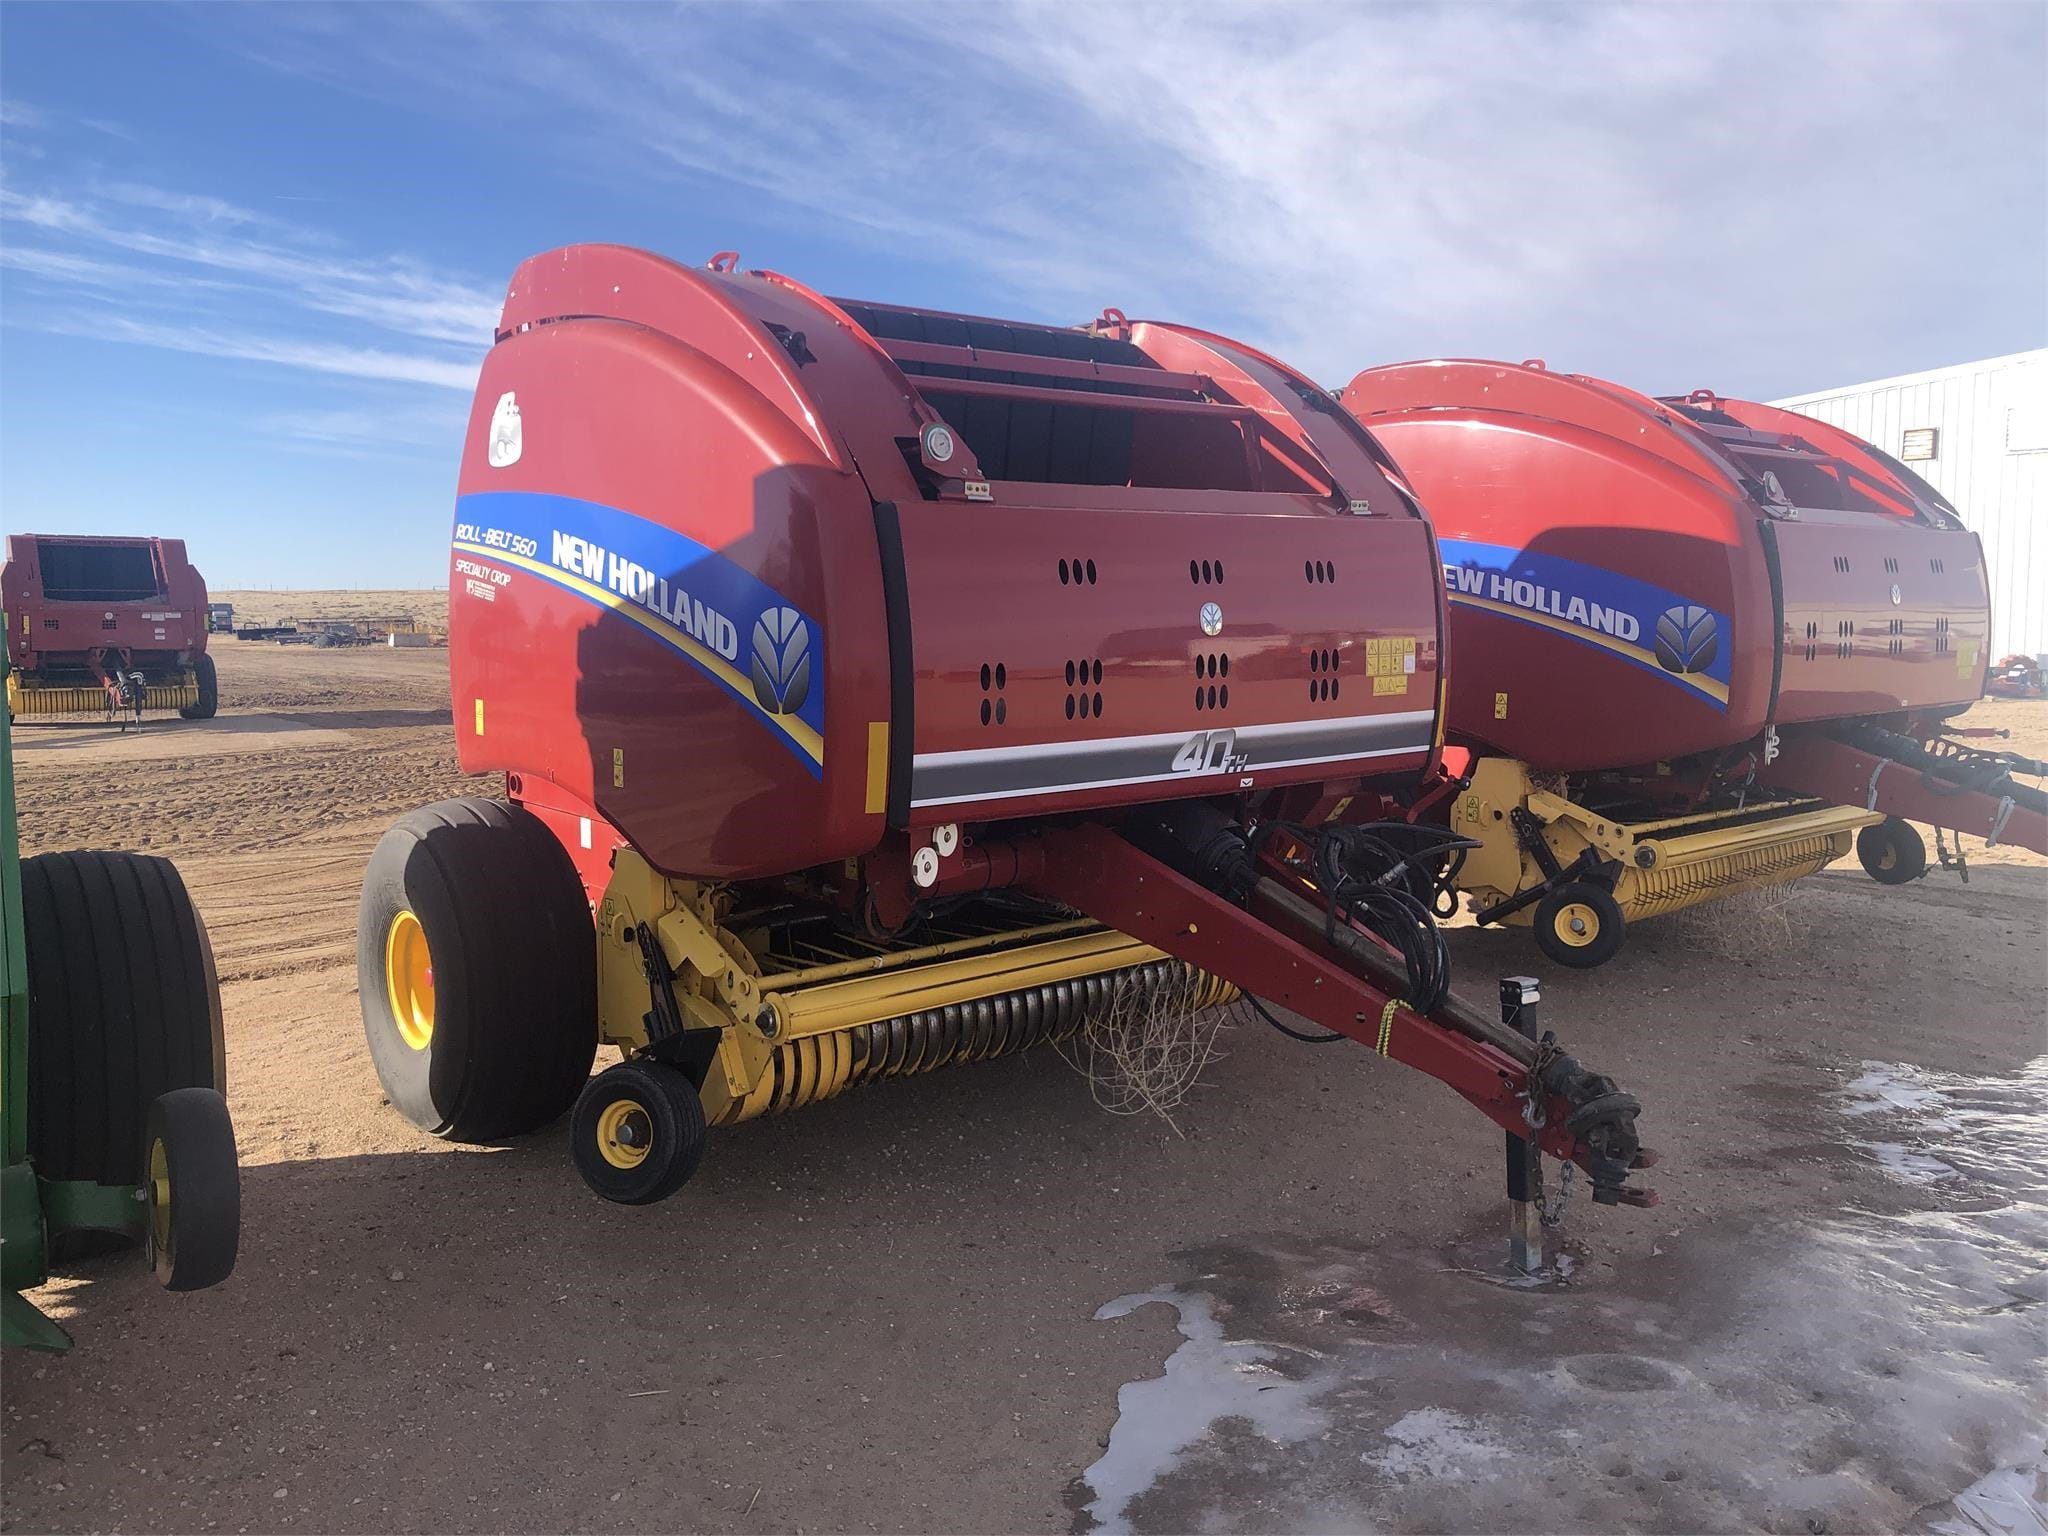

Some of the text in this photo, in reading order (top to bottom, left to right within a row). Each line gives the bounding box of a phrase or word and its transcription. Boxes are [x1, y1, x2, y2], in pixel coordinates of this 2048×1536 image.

[455, 523, 538, 557] ROLL-BELT 560
[454, 558, 512, 588] SPECIALTY CROP
[552, 529, 738, 662] NEW HOLLAND
[1442, 563, 1640, 642] EW HOLLAND
